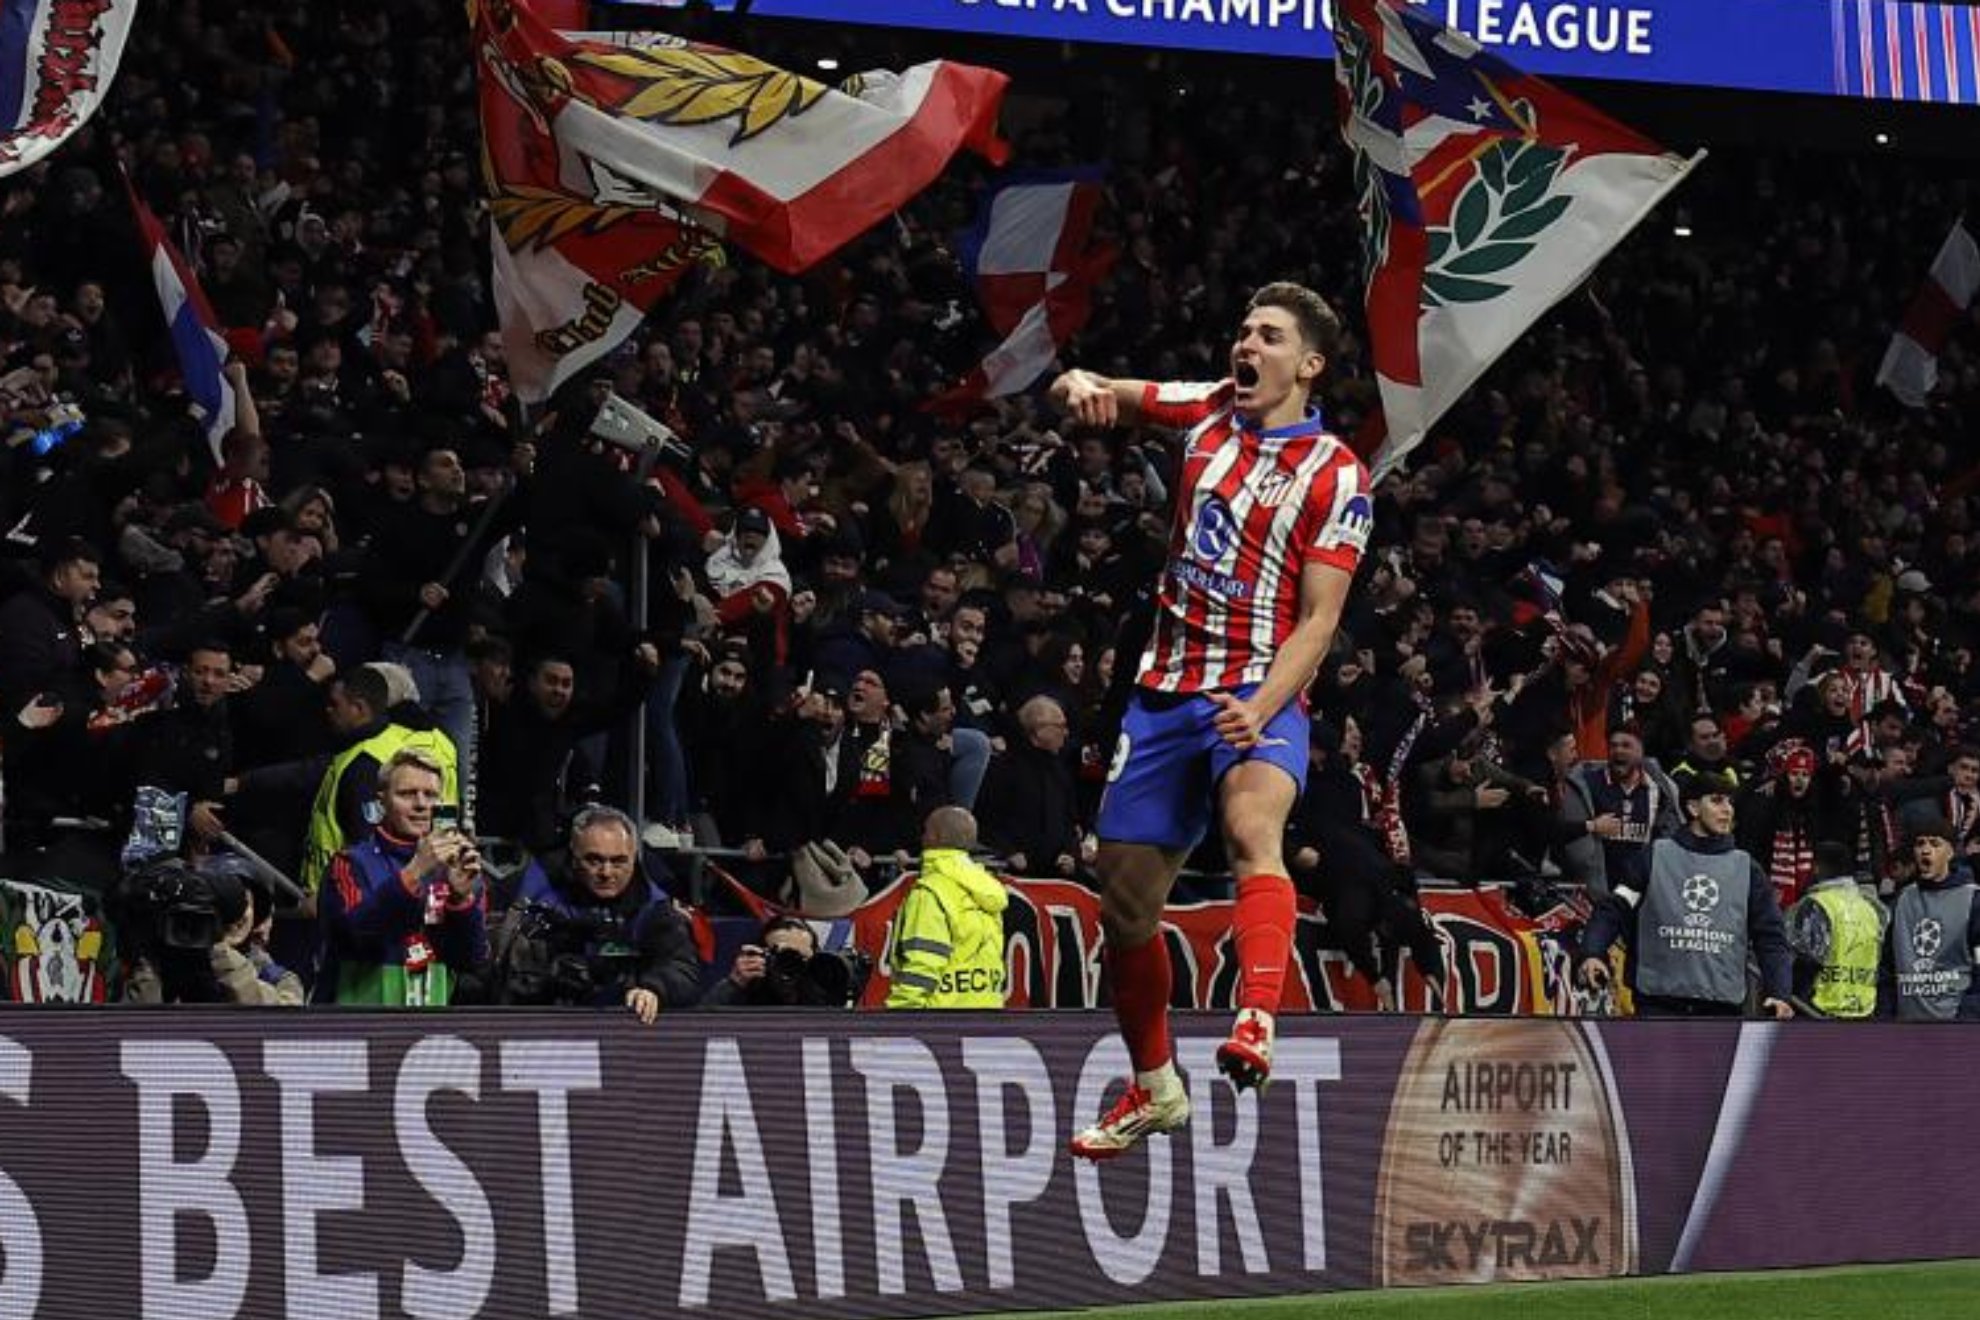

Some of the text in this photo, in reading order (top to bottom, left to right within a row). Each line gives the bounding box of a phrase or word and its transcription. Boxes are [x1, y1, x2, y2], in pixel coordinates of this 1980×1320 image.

[1446, 0, 1652, 53] LEAGUE
[1669, 939, 1721, 953] LEAGUE
[1441, 1061, 1576, 1113] AIRPORT
[1439, 1131, 1572, 1167] OF THE YEAR
[120, 1035, 601, 1320] BEST
[678, 1033, 1342, 1308] AIRPORT
[1404, 1216, 1601, 1272] SKYTRAX
